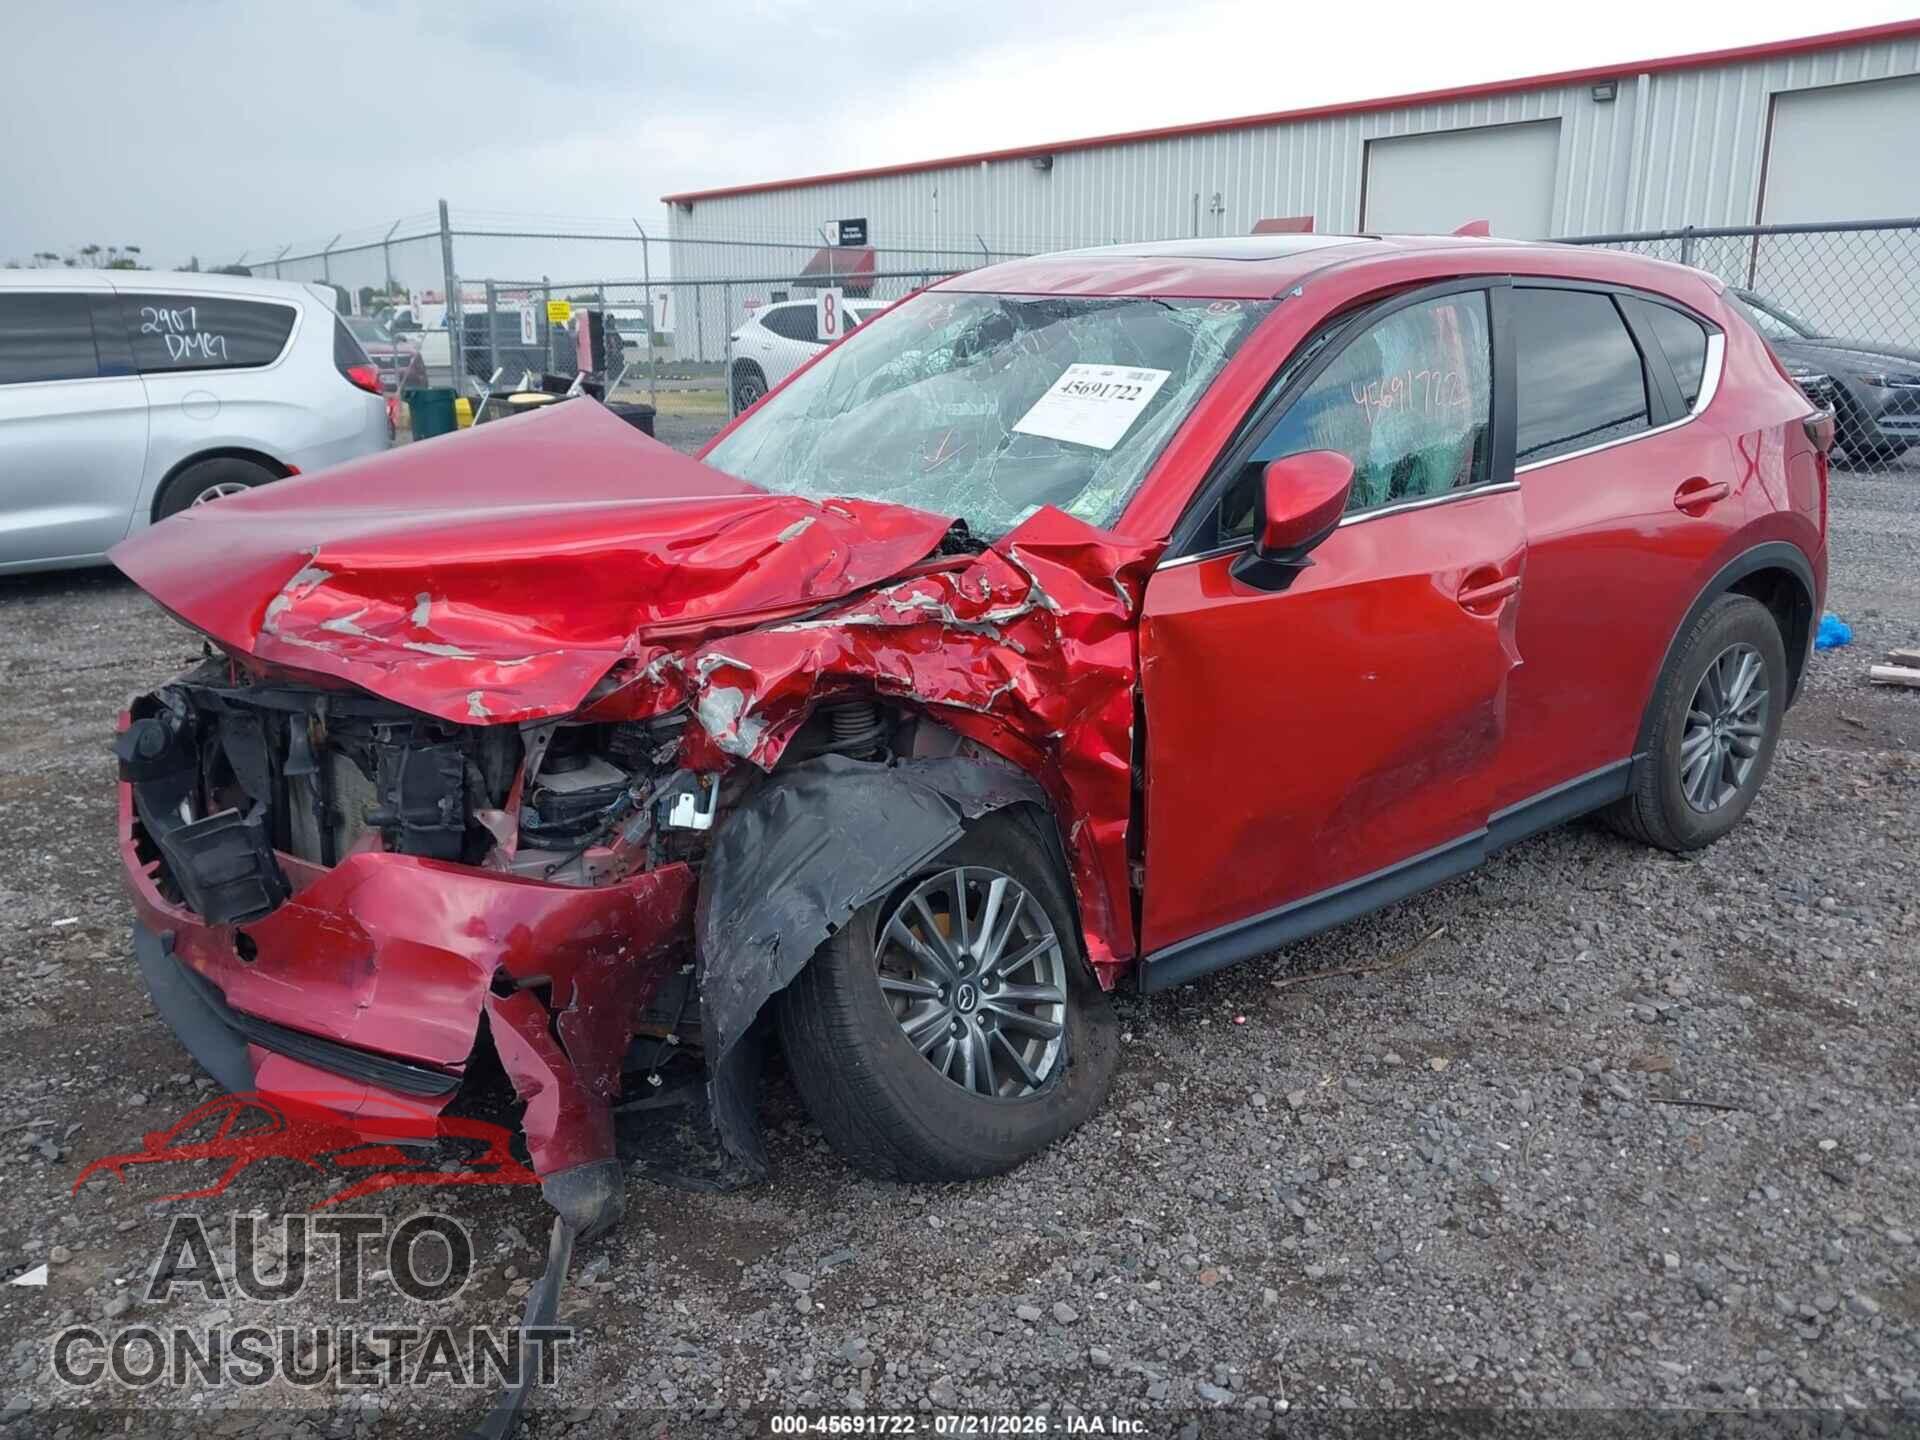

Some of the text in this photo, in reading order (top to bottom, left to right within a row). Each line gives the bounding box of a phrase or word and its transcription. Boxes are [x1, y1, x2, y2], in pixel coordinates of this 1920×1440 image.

[140, 306, 197, 334] 2907
[524, 308, 533, 340] 6
[658, 292, 669, 328] 7
[824, 293, 836, 335] 8
[1060, 380, 1143, 401] 45691722
[1350, 369, 1466, 423] 45691722
